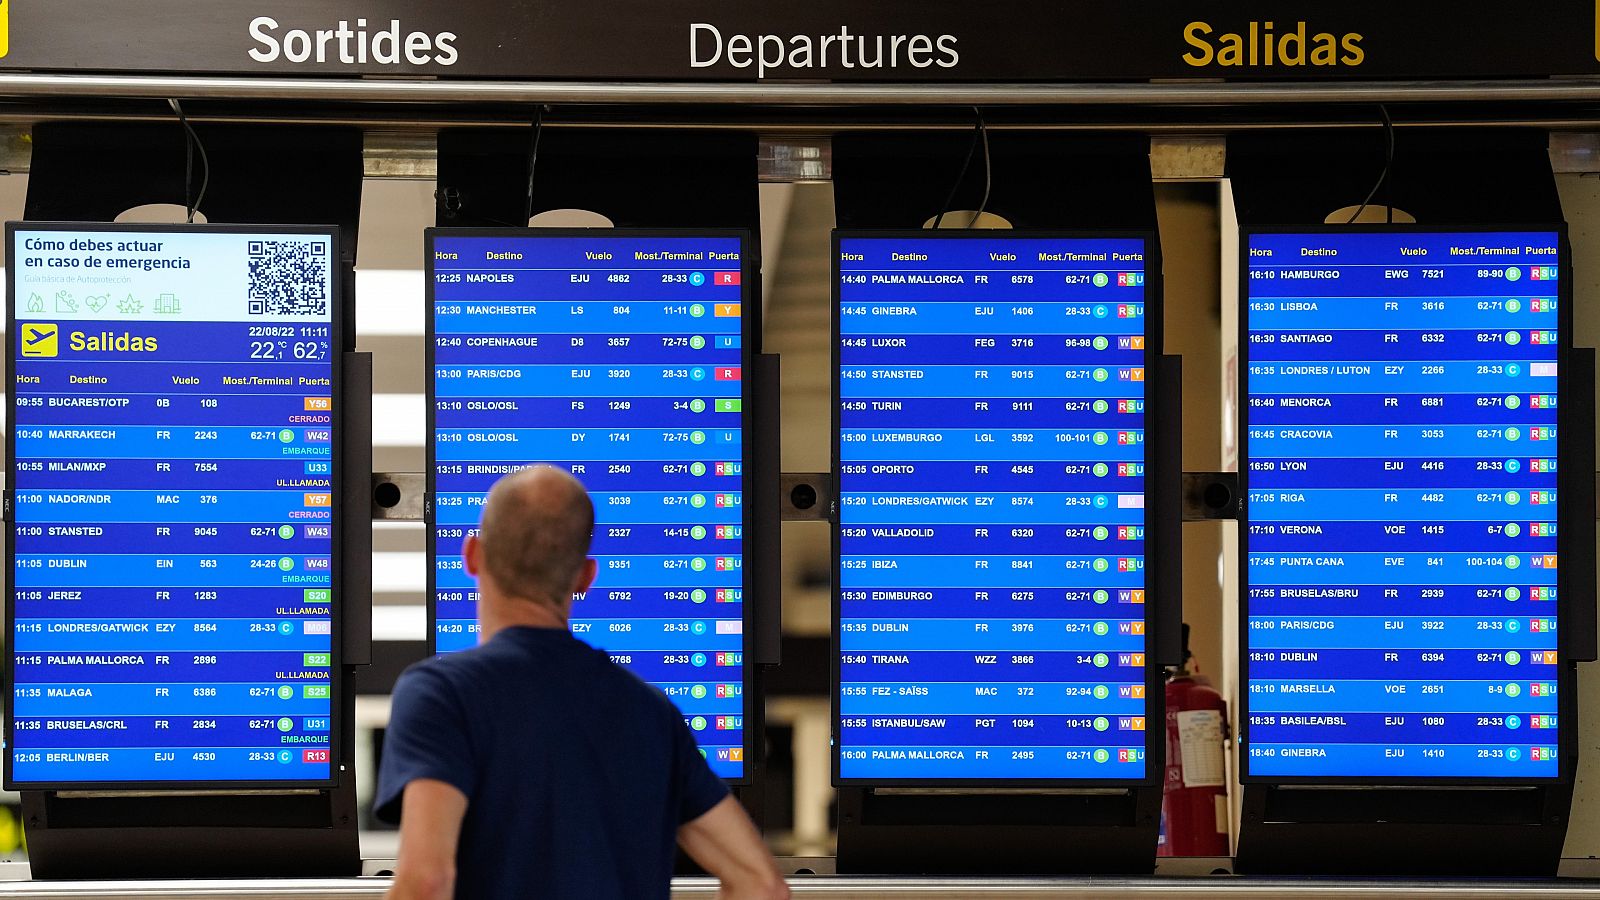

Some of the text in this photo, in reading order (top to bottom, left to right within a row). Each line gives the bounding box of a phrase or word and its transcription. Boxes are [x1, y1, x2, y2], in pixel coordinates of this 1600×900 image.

[247, 17, 459, 66] Sortides
[1182, 21, 1365, 67] Salidas
[689, 23, 959, 78] Departures
[24, 237, 164, 252] Cómo debes actuar
[435, 251, 740, 261] Hora Destino Vuelo Most./Terminal Puerta
[841, 252, 1143, 261] Hora Destino Vuelo Most./Terminal Puerta
[1249, 246, 1557, 257] Hora Destino Vuelo Most./Terminal Puerta
[24, 255, 191, 272] en caso de emergencia
[435, 273, 688, 283] 12:25 NAPOLES EJU 4862 28-33
[1249, 269, 1504, 279] 16:10 HAMBURGO EWG 7521 89-90
[435, 305, 687, 315] 12:30 MANCHESTER LS 804 11-11
[248, 326, 328, 337] 22/08/22 11:11
[69, 331, 158, 352] Salidas
[435, 337, 688, 347] 12:40 COPENHAGUE D8 3657 72-75
[841, 338, 1091, 347] 14:45 LUXOR FEG 3716 96-98
[16, 374, 330, 386] Hora Destino Vuelo Most./Terminal Puerta
[16, 397, 43, 407] 09:55
[48, 397, 130, 407] BUCAREST/OTP
[200, 398, 218, 408] 108
[308, 399, 328, 409] Y56
[1249, 397, 1502, 407] 16:40 MENORCA FR 6881 62-71
[288, 415, 331, 423] CERRADO
[16, 430, 43, 439] 10:40
[48, 430, 116, 439] MARRAKECH
[156, 430, 171, 440] FR
[194, 431, 218, 440] 2243
[250, 431, 276, 440] 62-71
[307, 431, 329, 441] W42
[436, 433, 689, 442] 13:10 OSLO/OSL DY 1741 72-75
[841, 433, 1090, 442] 15:00 LUXEMBURGO LGL 3592 100-101
[281, 446, 331, 456] EMBARQUE
[841, 528, 1090, 538] 15:20 VALLADOLID FR 6320 62-71
[1249, 557, 1503, 566] 17:45 PUNTA CANA EVE 841 100-104
[15, 591, 327, 600] 11:05 JEREZ FR 1283 S20
[436, 591, 689, 601] 14:00 6792 19-20
[276, 607, 330, 615] UL.LLAMADA
[437, 623, 689, 633] 14:20 EZY 6026 28-33
[841, 623, 1090, 632] 15:35 DUBLIN FR 3976 62-71
[1249, 652, 1502, 662] 18:10 DUBLIN FR 6394 62-71
[15, 720, 41, 730] 11:35
[46, 720, 128, 730] BRUSELAS/CRL
[155, 720, 169, 729] FR
[192, 720, 217, 729] 2834
[249, 719, 275, 729] 62-71
[306, 719, 326, 729] U31
[841, 718, 1092, 728] 15:55 ISTANBUL/SAW PGT 1094 10-13
[280, 735, 329, 744] EMBARQUE
[1250, 748, 1504, 758] 18:40 GINEBRA EJU 1410 28-33
